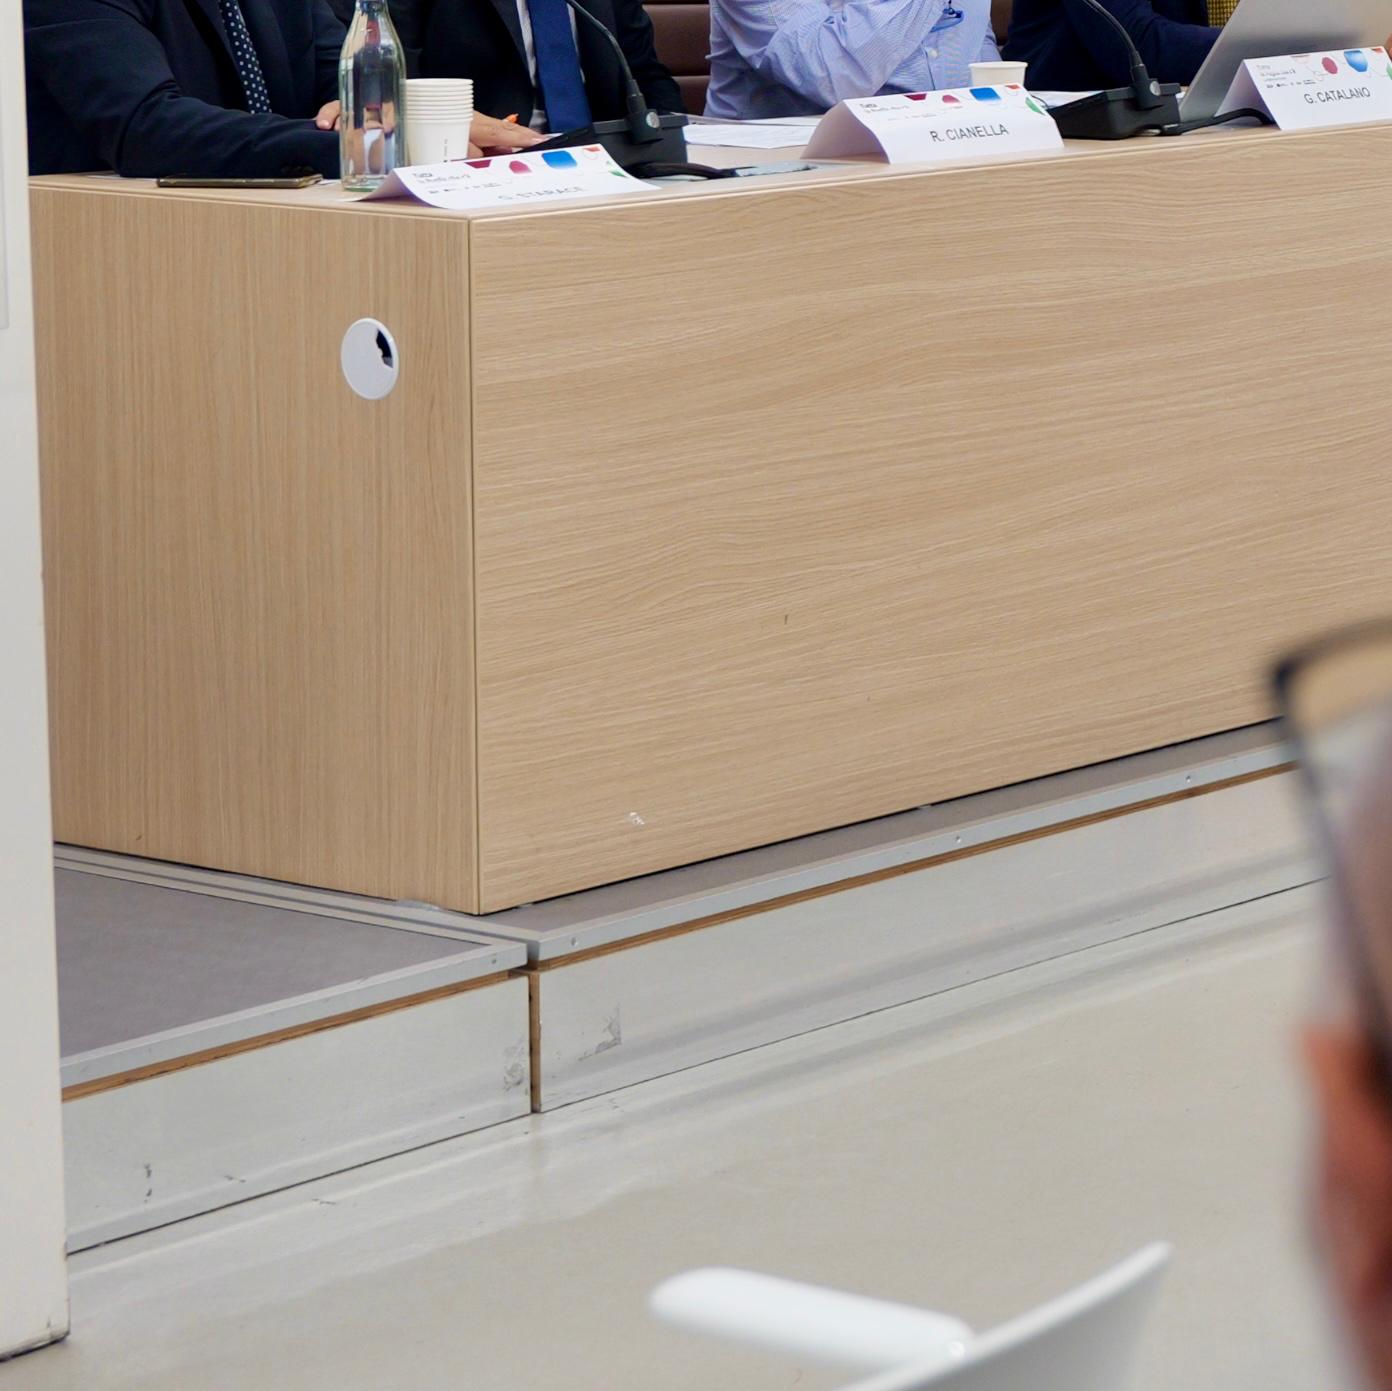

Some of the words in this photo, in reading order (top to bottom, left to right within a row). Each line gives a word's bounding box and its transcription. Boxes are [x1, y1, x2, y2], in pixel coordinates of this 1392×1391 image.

[1303, 93, 1318, 105] G.
[1318, 87, 1371, 103] CATALANO
[930, 130, 945, 143] R.
[949, 123, 1009, 141] CIANELLA
